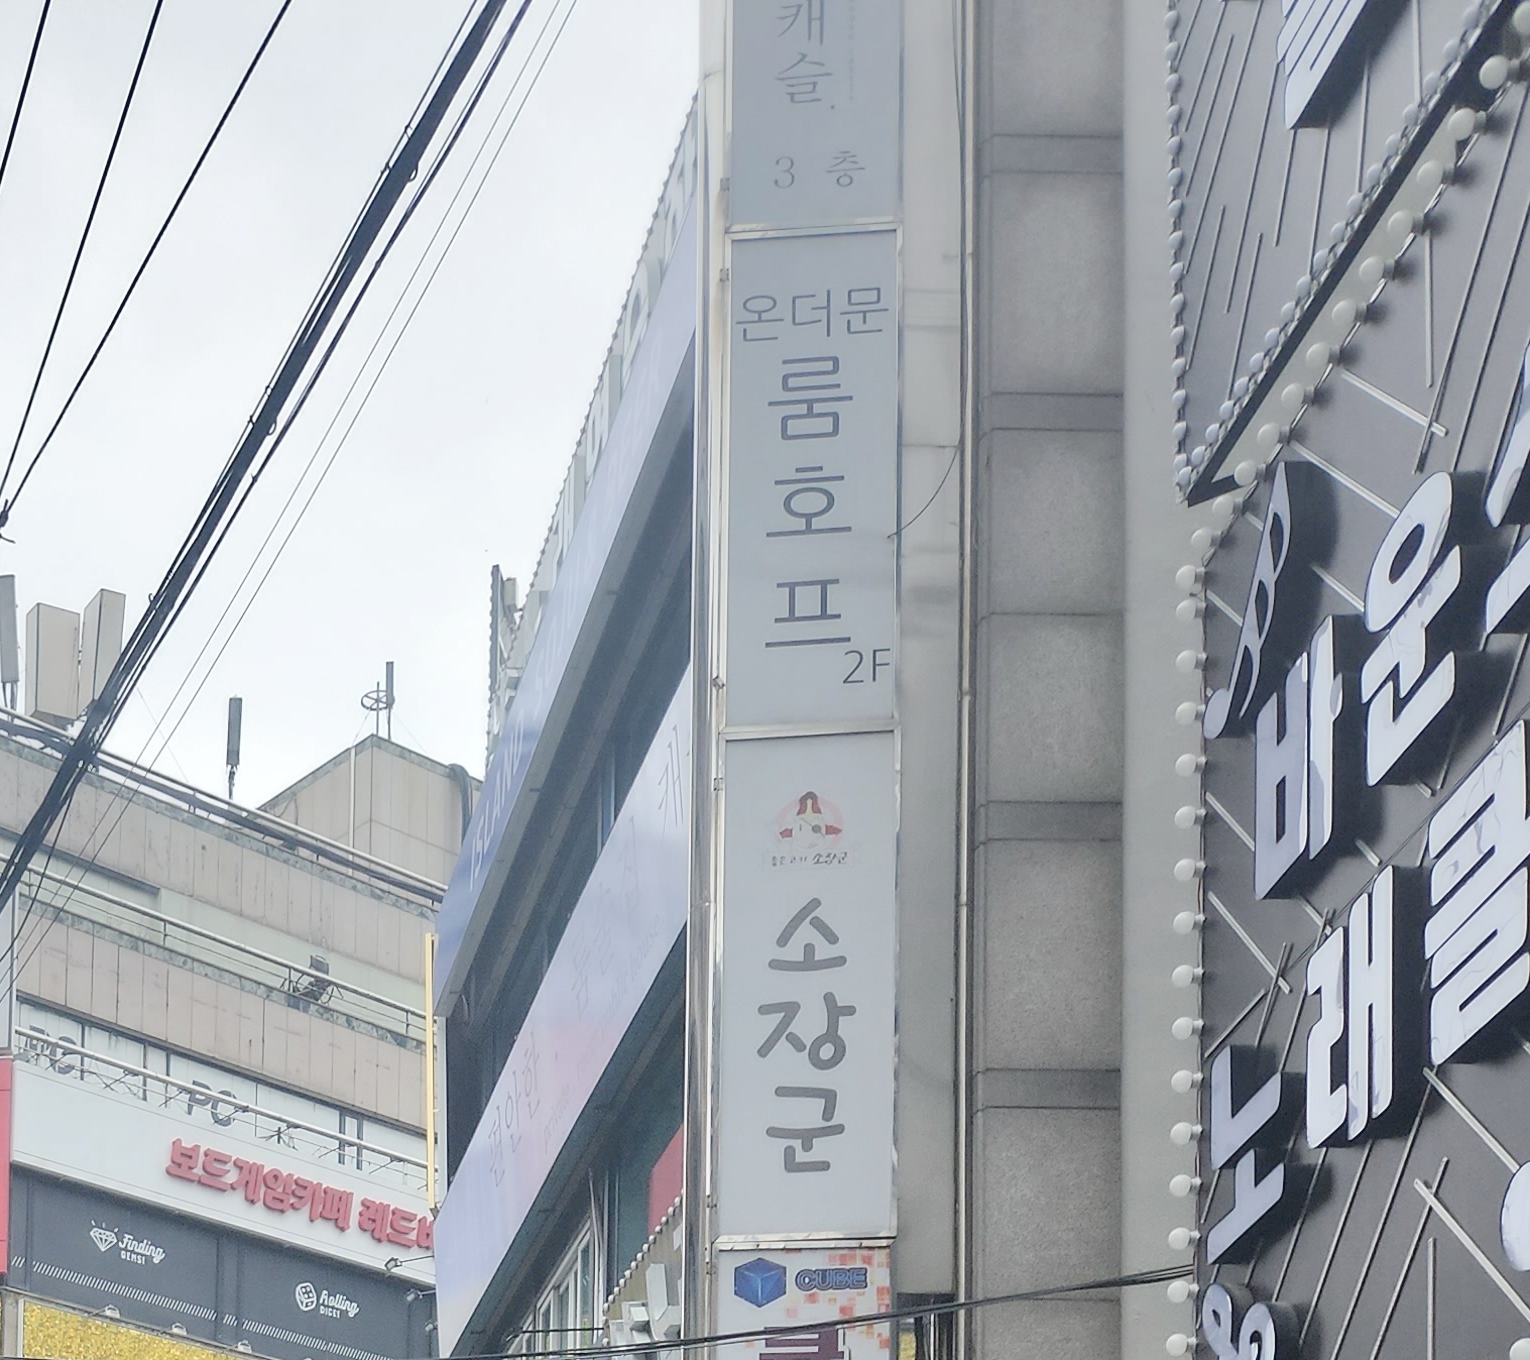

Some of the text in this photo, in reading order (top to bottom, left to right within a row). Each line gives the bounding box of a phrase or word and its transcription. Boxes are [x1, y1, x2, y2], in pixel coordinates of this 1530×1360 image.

[773, 149, 866, 190] 3 층
[734, 286, 891, 342] 온더문
[765, 355, 854, 650] 룸호프
[841, 648, 891, 685] 2F
[756, 895, 847, 1178] 소장군
[165, 1138, 355, 1234] 보드게임카페
[119, 1232, 166, 1266] Finding
[793, 1267, 869, 1292] CUBE
[319, 1289, 360, 1319] Rolling
